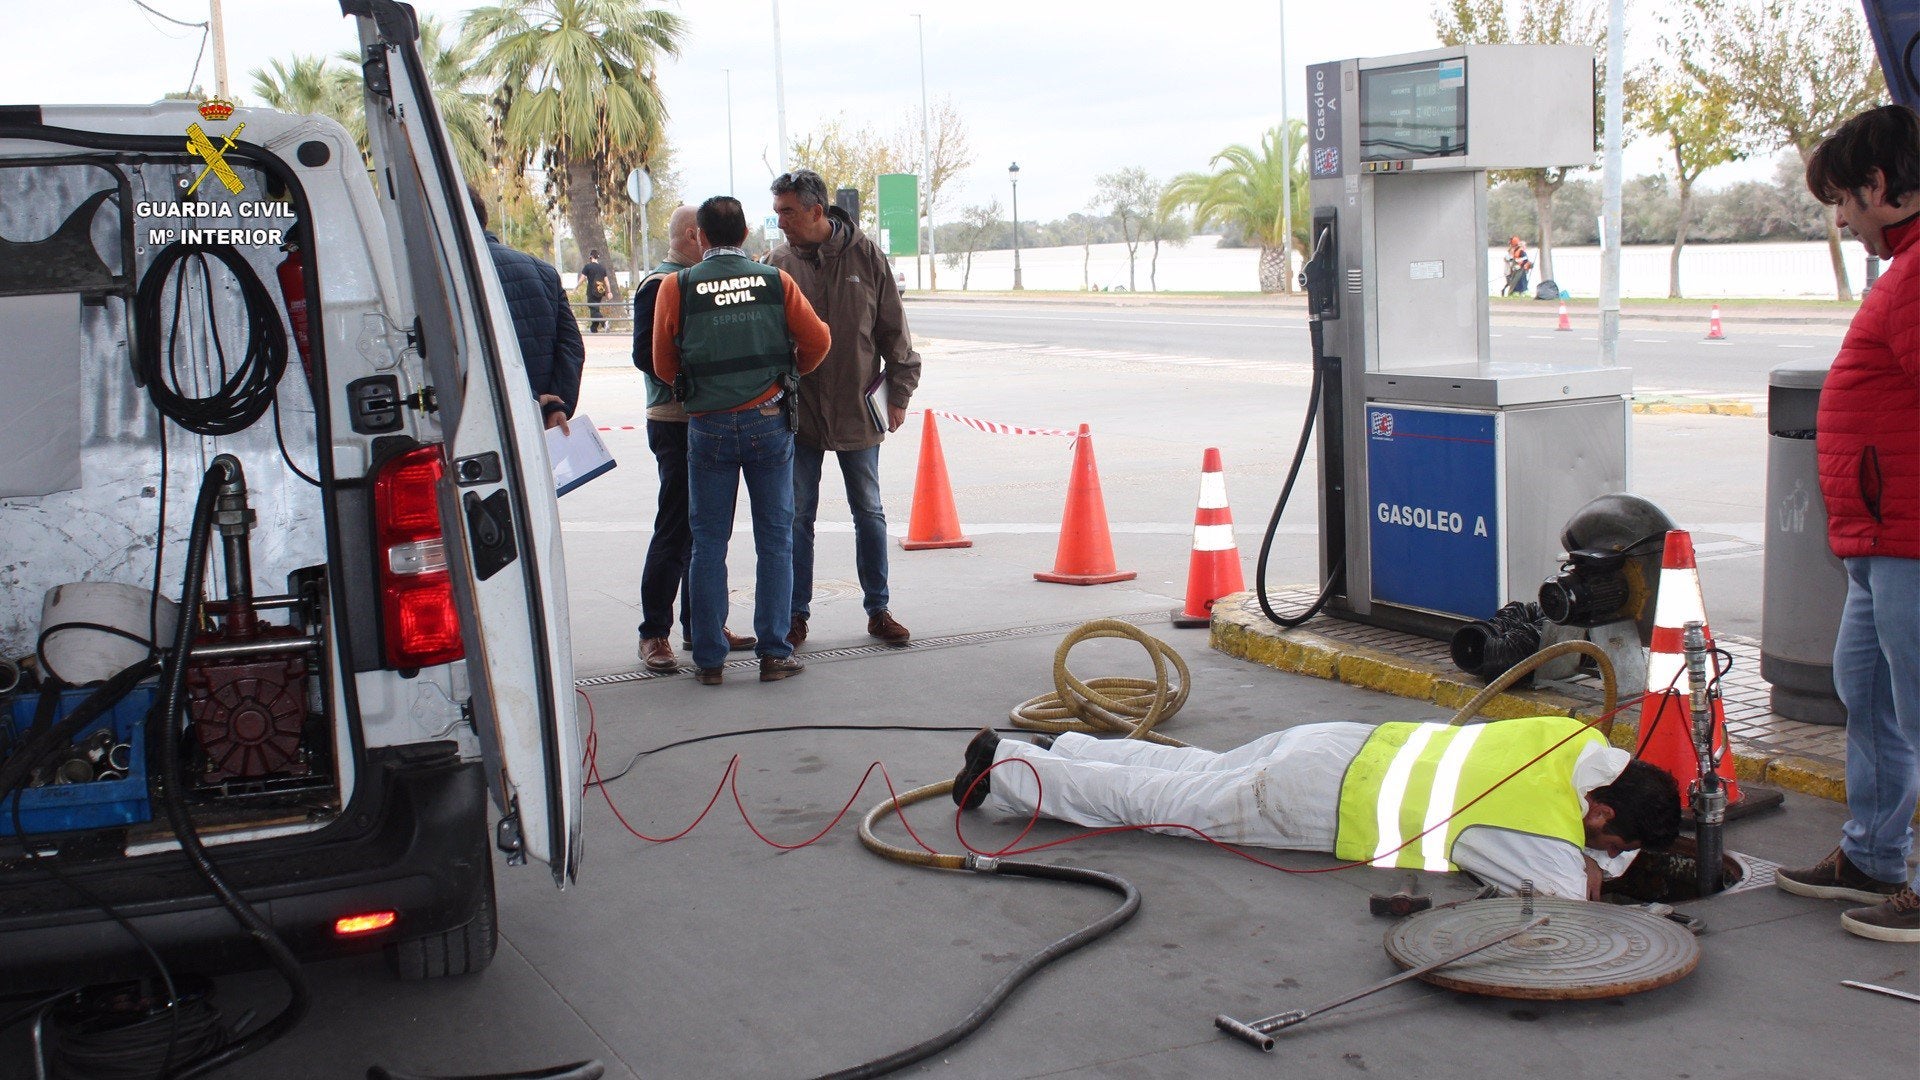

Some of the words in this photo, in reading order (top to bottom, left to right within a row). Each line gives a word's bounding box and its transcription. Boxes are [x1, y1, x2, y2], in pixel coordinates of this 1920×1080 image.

[1314, 70, 1325, 141] Gasóleo
[1327, 97, 1336, 110] A
[696, 276, 767, 295] GUARDIA
[714, 290, 756, 306] CIVIL
[713, 311, 761, 326] SEPRONA
[1377, 502, 1463, 534] GASOLEO
[1473, 516, 1488, 538] A
